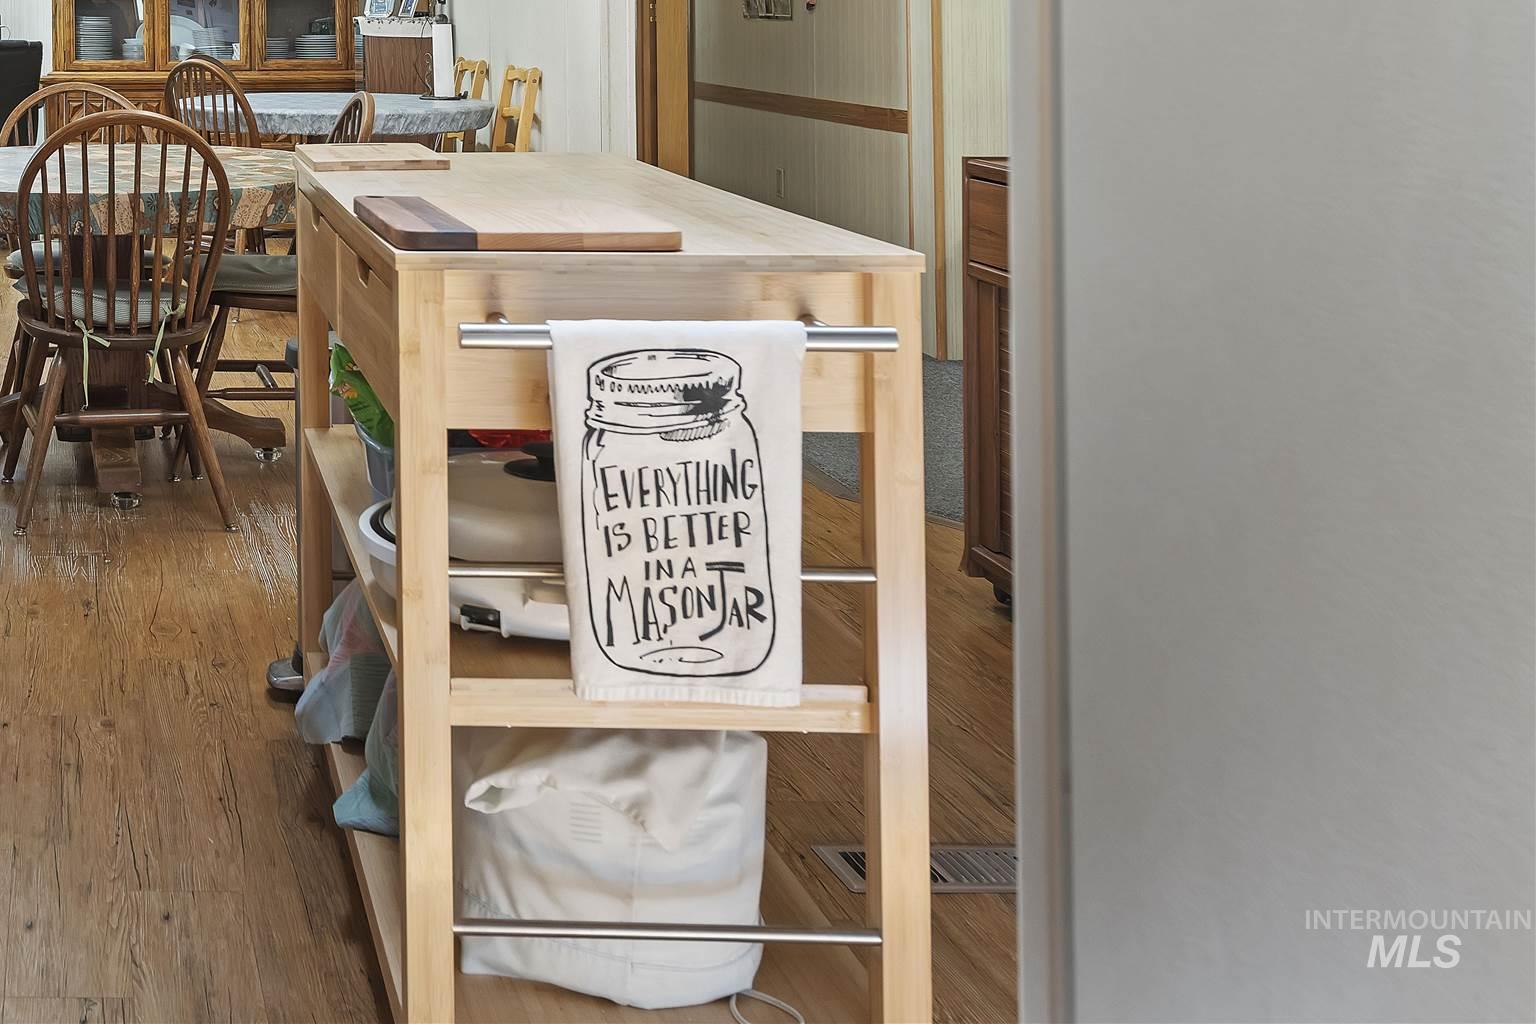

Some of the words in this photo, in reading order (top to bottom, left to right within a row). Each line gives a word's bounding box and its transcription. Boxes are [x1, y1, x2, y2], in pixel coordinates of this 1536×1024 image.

[600, 448, 759, 512] EVERYTHING
[604, 522, 632, 557] IS
[643, 511, 752, 553] BETTER
[644, 560, 673, 581] IN
[680, 556, 697, 580] A
[605, 576, 716, 647] MASON
[698, 561, 768, 642] JAR
